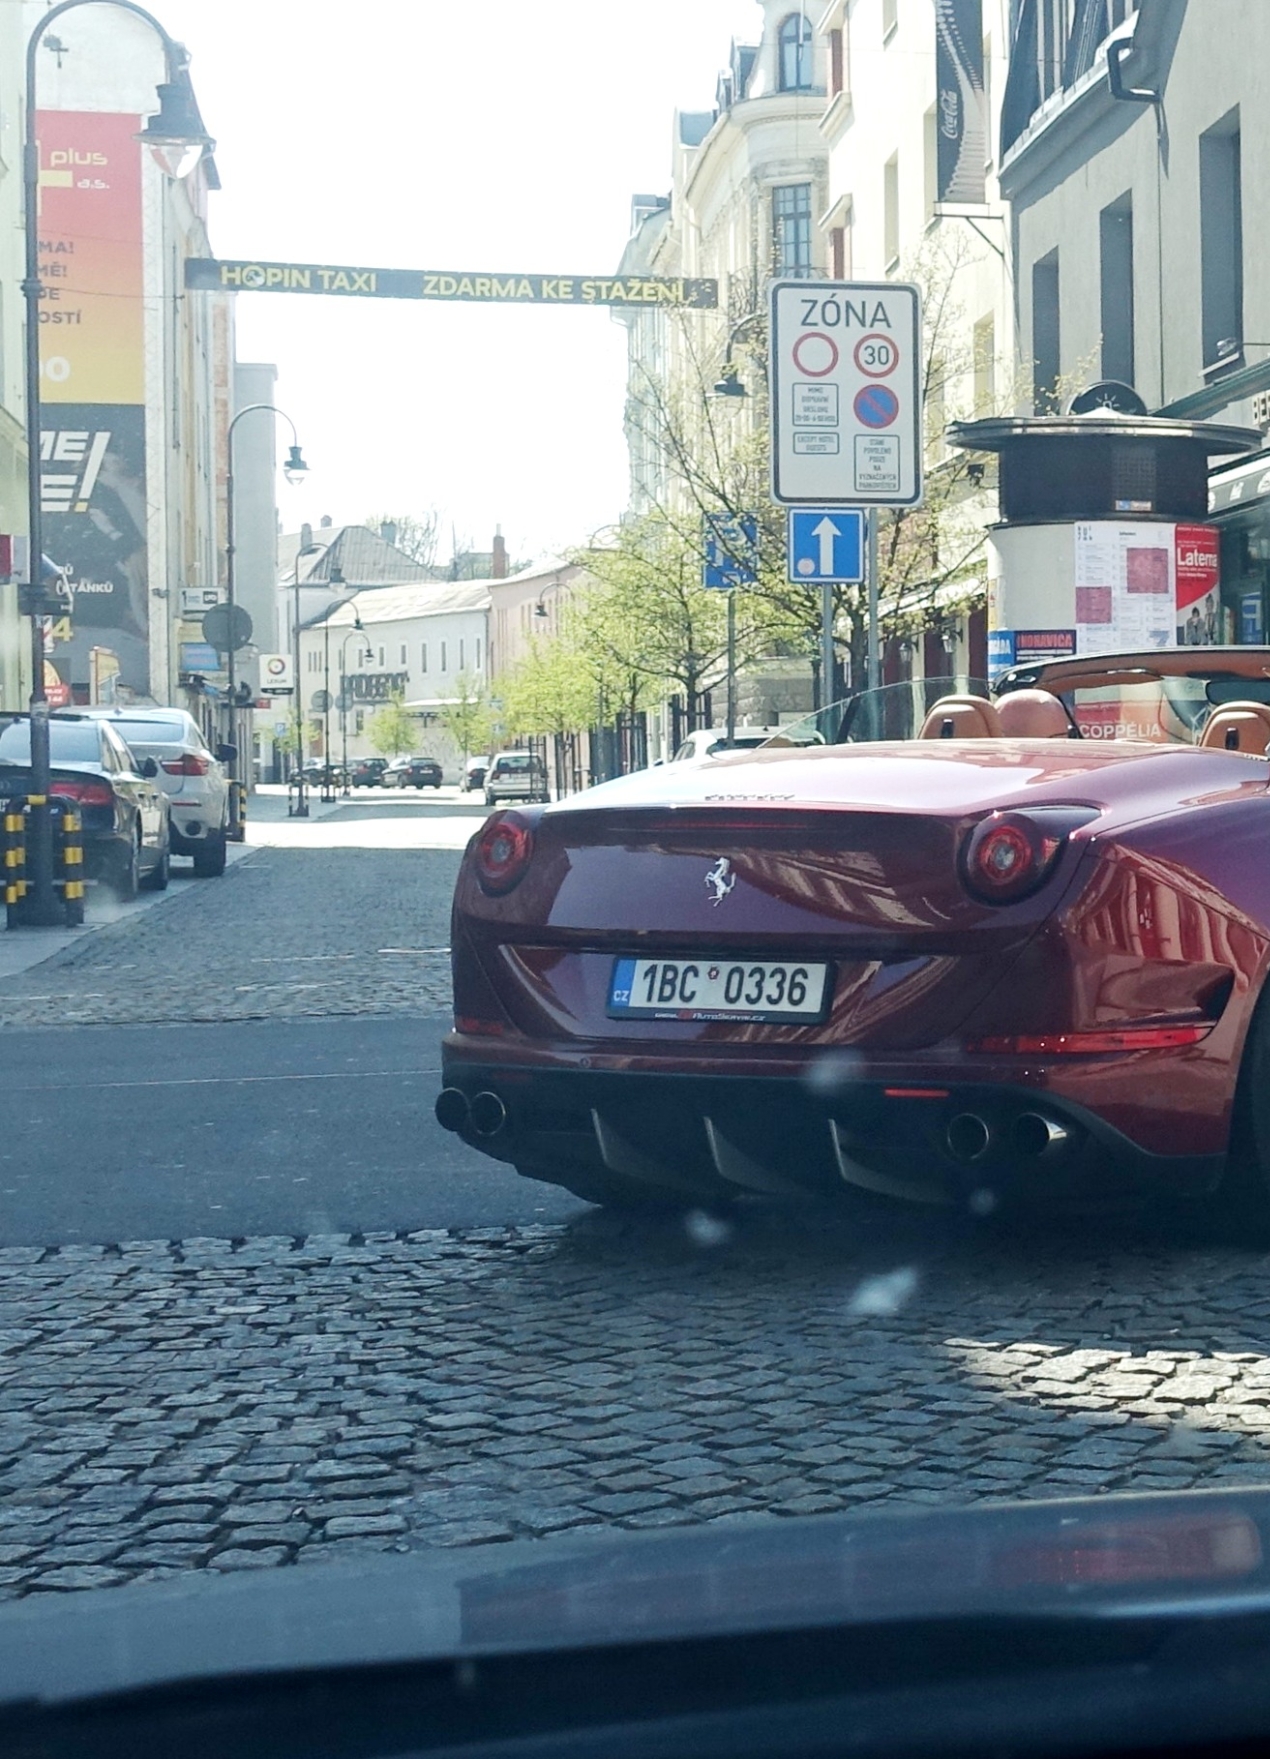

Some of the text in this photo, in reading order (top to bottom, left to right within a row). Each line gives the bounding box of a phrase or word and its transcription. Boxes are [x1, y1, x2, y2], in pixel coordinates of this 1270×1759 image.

[50, 148, 108, 167] plus
[77, 178, 110, 190] a.s.
[220, 265, 376, 292] HOPIN TAXI
[422, 275, 686, 302] ZDARMA KE STAŽENÍ
[800, 293, 892, 329] ZÓNA
[863, 345, 890, 366] 30
[1080, 722, 1162, 738] COPPÉLIA
[643, 963, 809, 1006] 1BC 0336
[613, 990, 630, 1002] CZ
